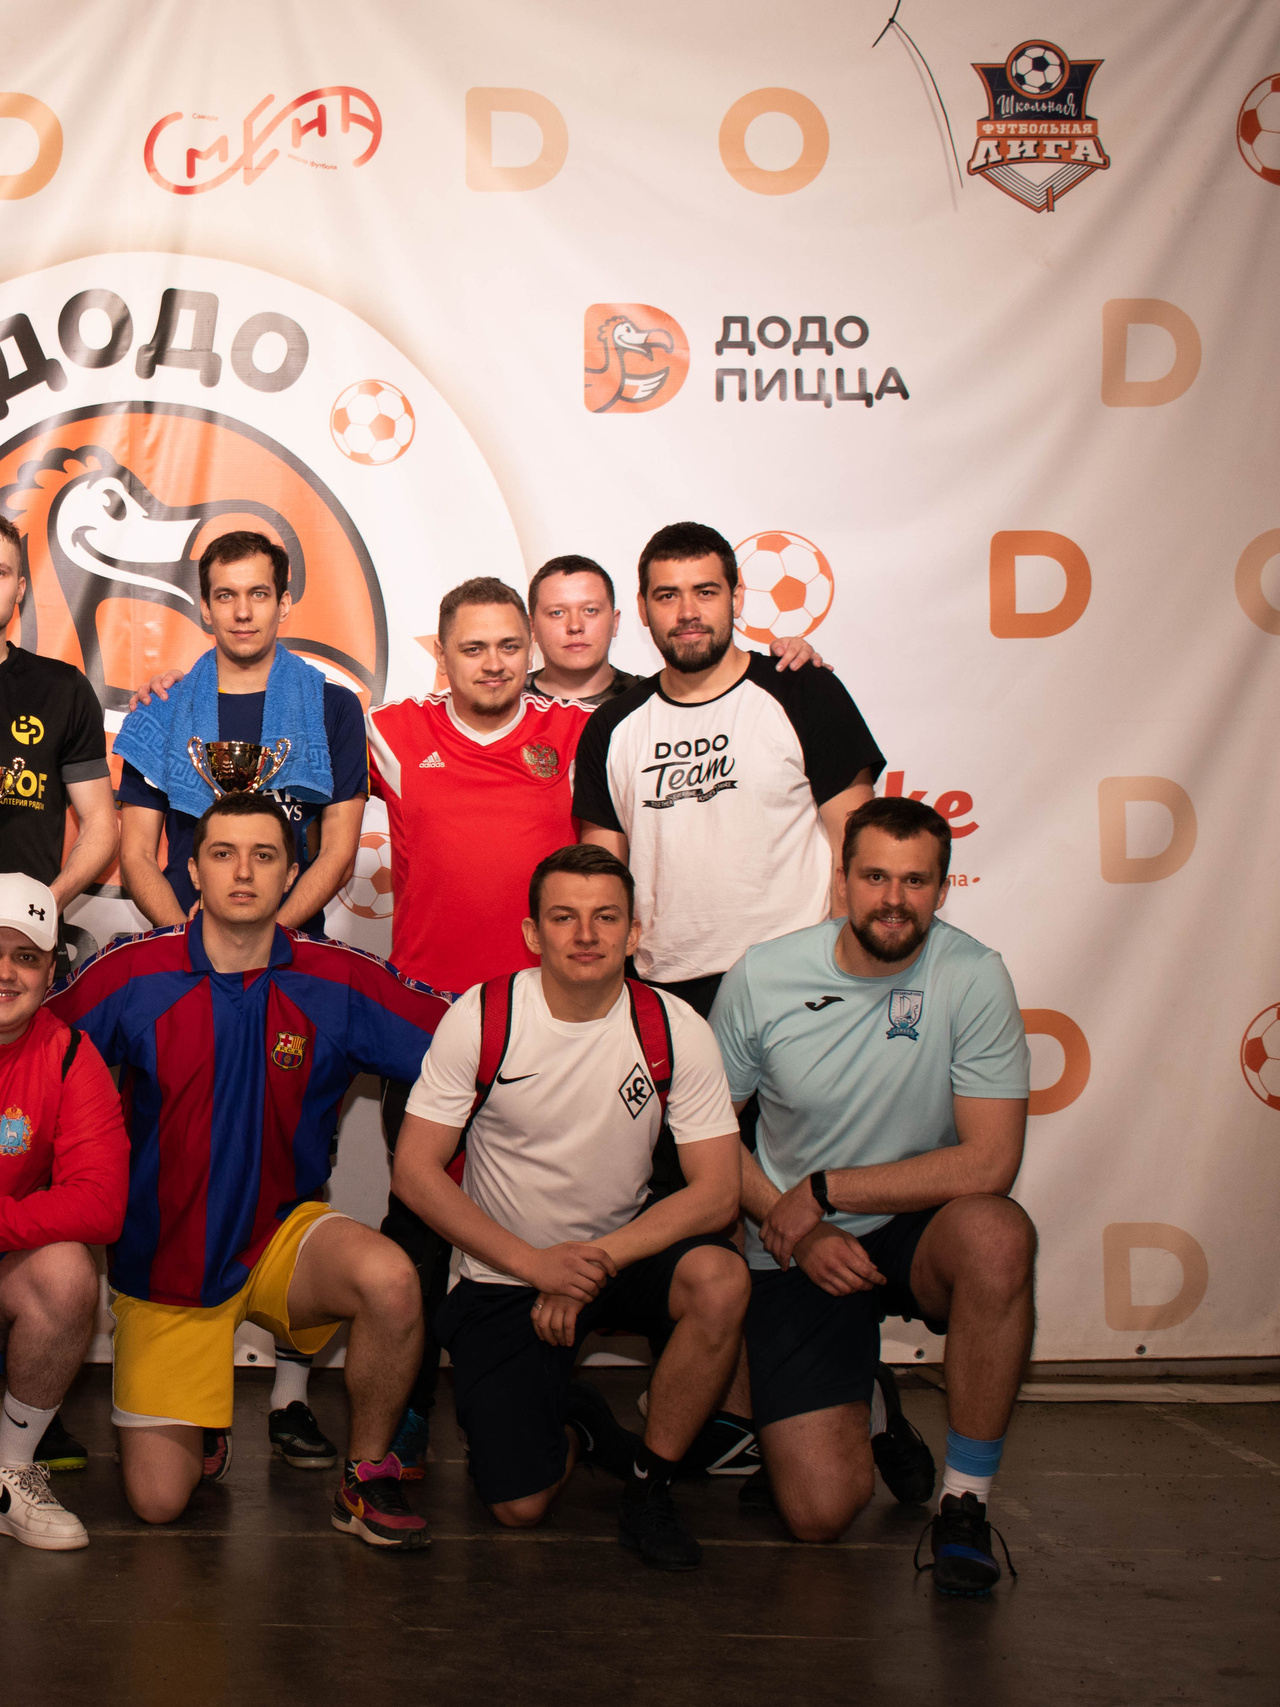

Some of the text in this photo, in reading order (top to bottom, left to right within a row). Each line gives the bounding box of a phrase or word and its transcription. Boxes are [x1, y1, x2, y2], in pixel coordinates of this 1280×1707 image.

[996, 92, 1079, 118] Школьная
[465, 86, 570, 193] D
[981, 123, 1093, 135] ФУТБОЛЬНАЯ
[970, 138, 1106, 170] ЛИГА
[715, 315, 869, 356] ДОДО
[1101, 298, 1202, 408] D
[715, 366, 910, 408] ПИЦЦА
[989, 530, 1091, 639] D
[654, 734, 729, 759] DODO
[641, 755, 735, 798] Team
[1098, 776, 1197, 884] D
[1102, 1222, 1208, 1331] D
